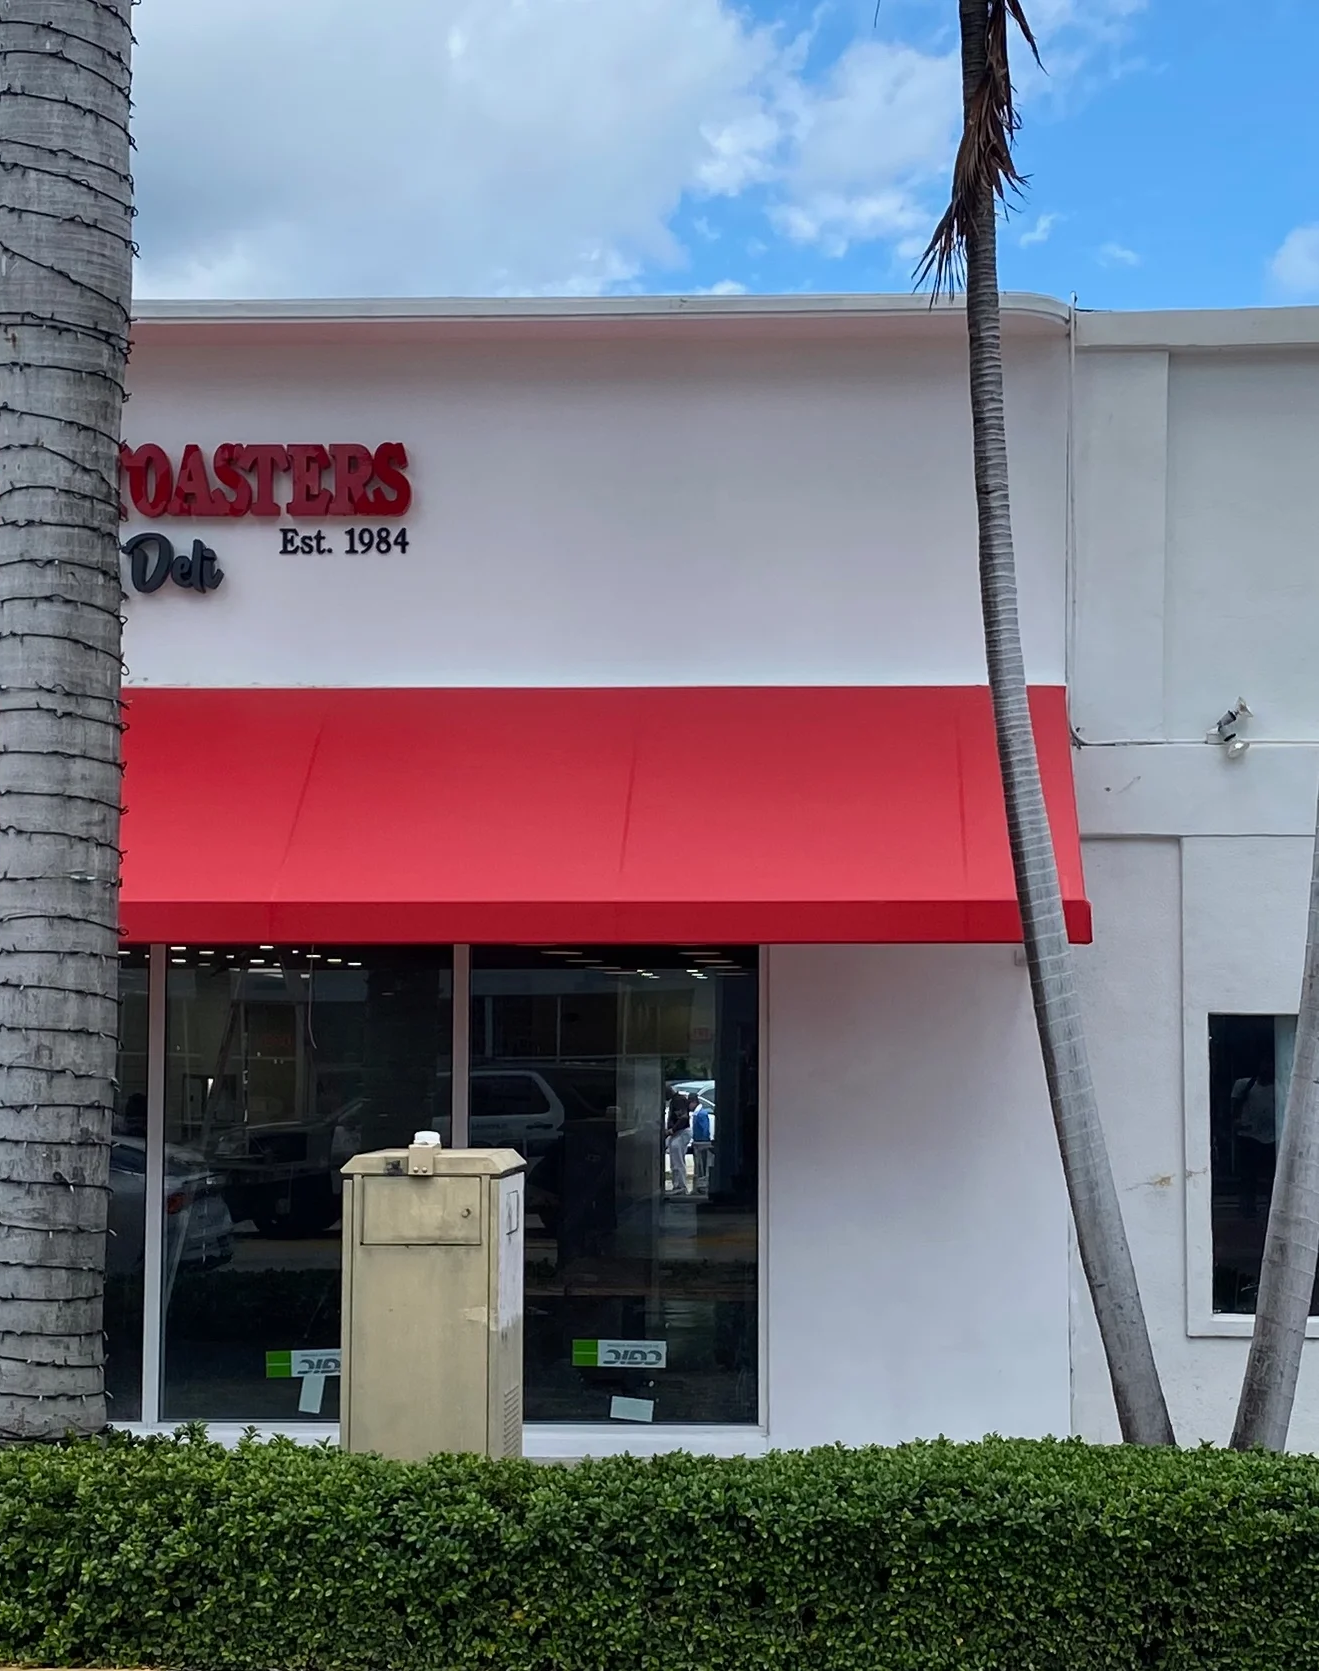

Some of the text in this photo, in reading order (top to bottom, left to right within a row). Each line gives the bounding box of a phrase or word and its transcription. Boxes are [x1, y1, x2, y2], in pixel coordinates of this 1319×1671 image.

[120, 442, 412, 517] OASTERS
[121, 532, 224, 593] Deli
[279, 527, 409, 554] Est. 1984
